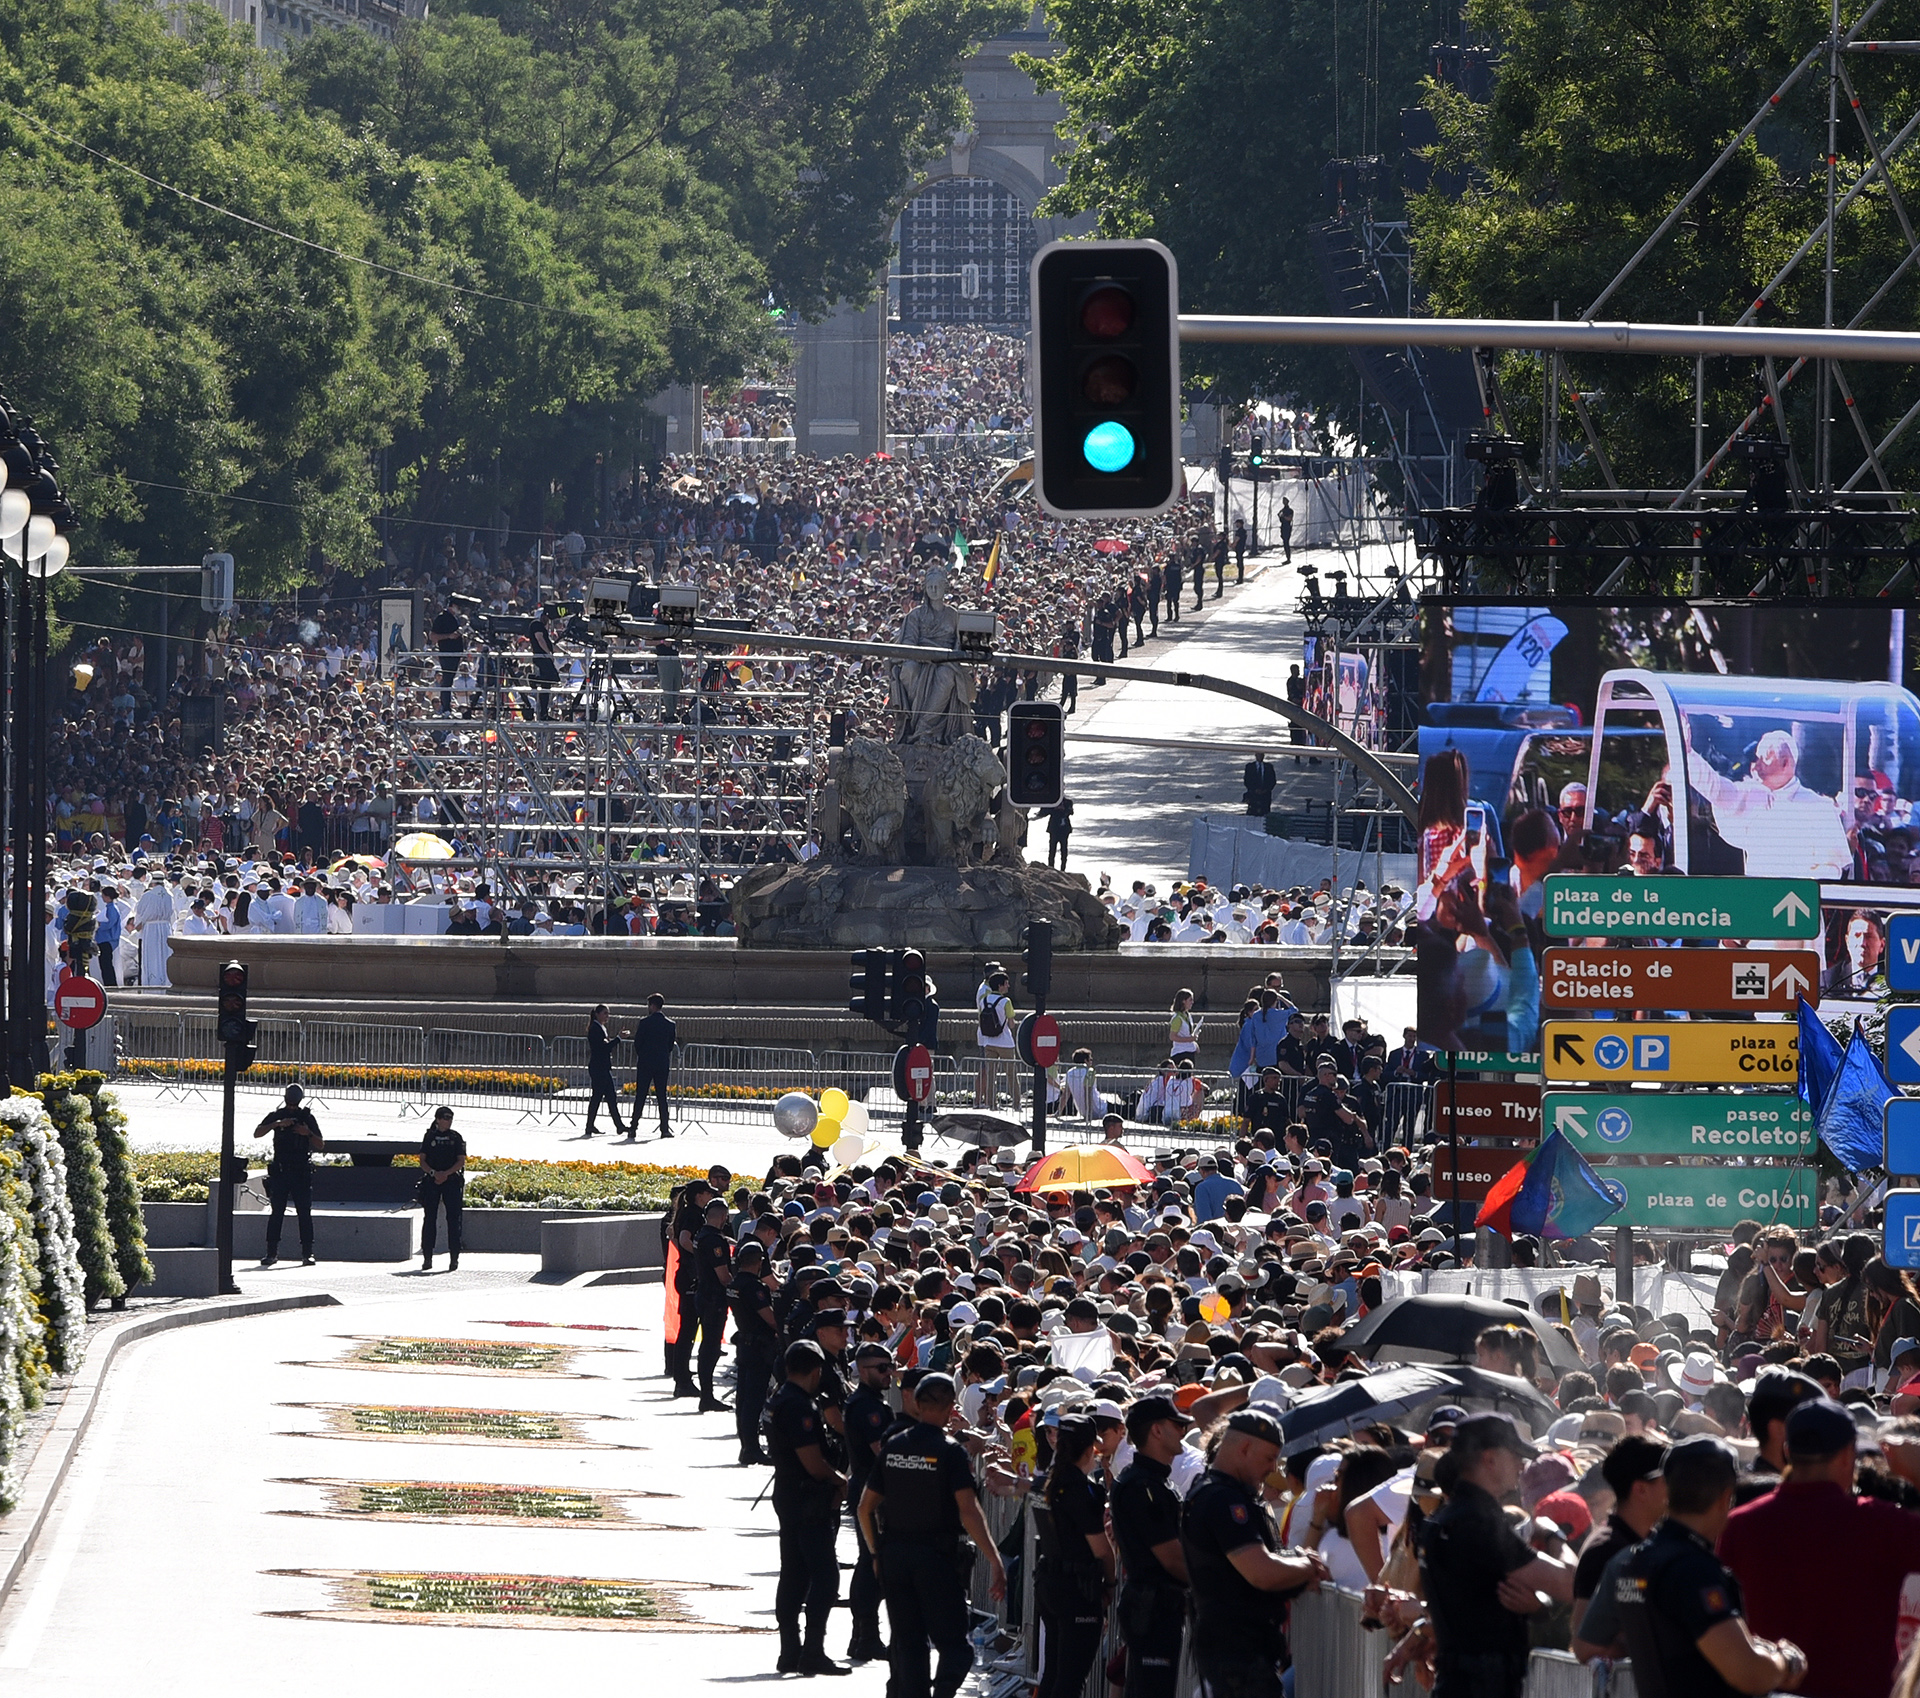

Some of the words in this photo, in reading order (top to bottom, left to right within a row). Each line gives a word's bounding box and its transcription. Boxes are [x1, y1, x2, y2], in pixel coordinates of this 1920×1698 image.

[1553, 889, 1600, 905] plaza
[1611, 889, 1633, 903] de
[1643, 889, 1659, 903] la
[1552, 906, 1732, 929] Independencia
[1552, 959, 1632, 978] Palacio
[1646, 961, 1673, 978] de
[1552, 980, 1634, 998] Cibeles
[1730, 1036, 1776, 1051] plaza
[1788, 1036, 1799, 1050] d
[1445, 1051, 1493, 1064] mp.
[1738, 1053, 1800, 1072] Coló
[1442, 1105, 1492, 1118] museo
[1501, 1102, 1542, 1122] Thy
[1726, 1110, 1779, 1123] paseo
[1790, 1108, 1812, 1122] de
[1691, 1125, 1812, 1145] Recoletos
[1442, 1170, 1492, 1183] museo
[1647, 1192, 1694, 1209] plaza
[1705, 1193, 1727, 1208] de
[1738, 1187, 1810, 1209] Colón
[886, 1461, 937, 1471] NACIONAL
